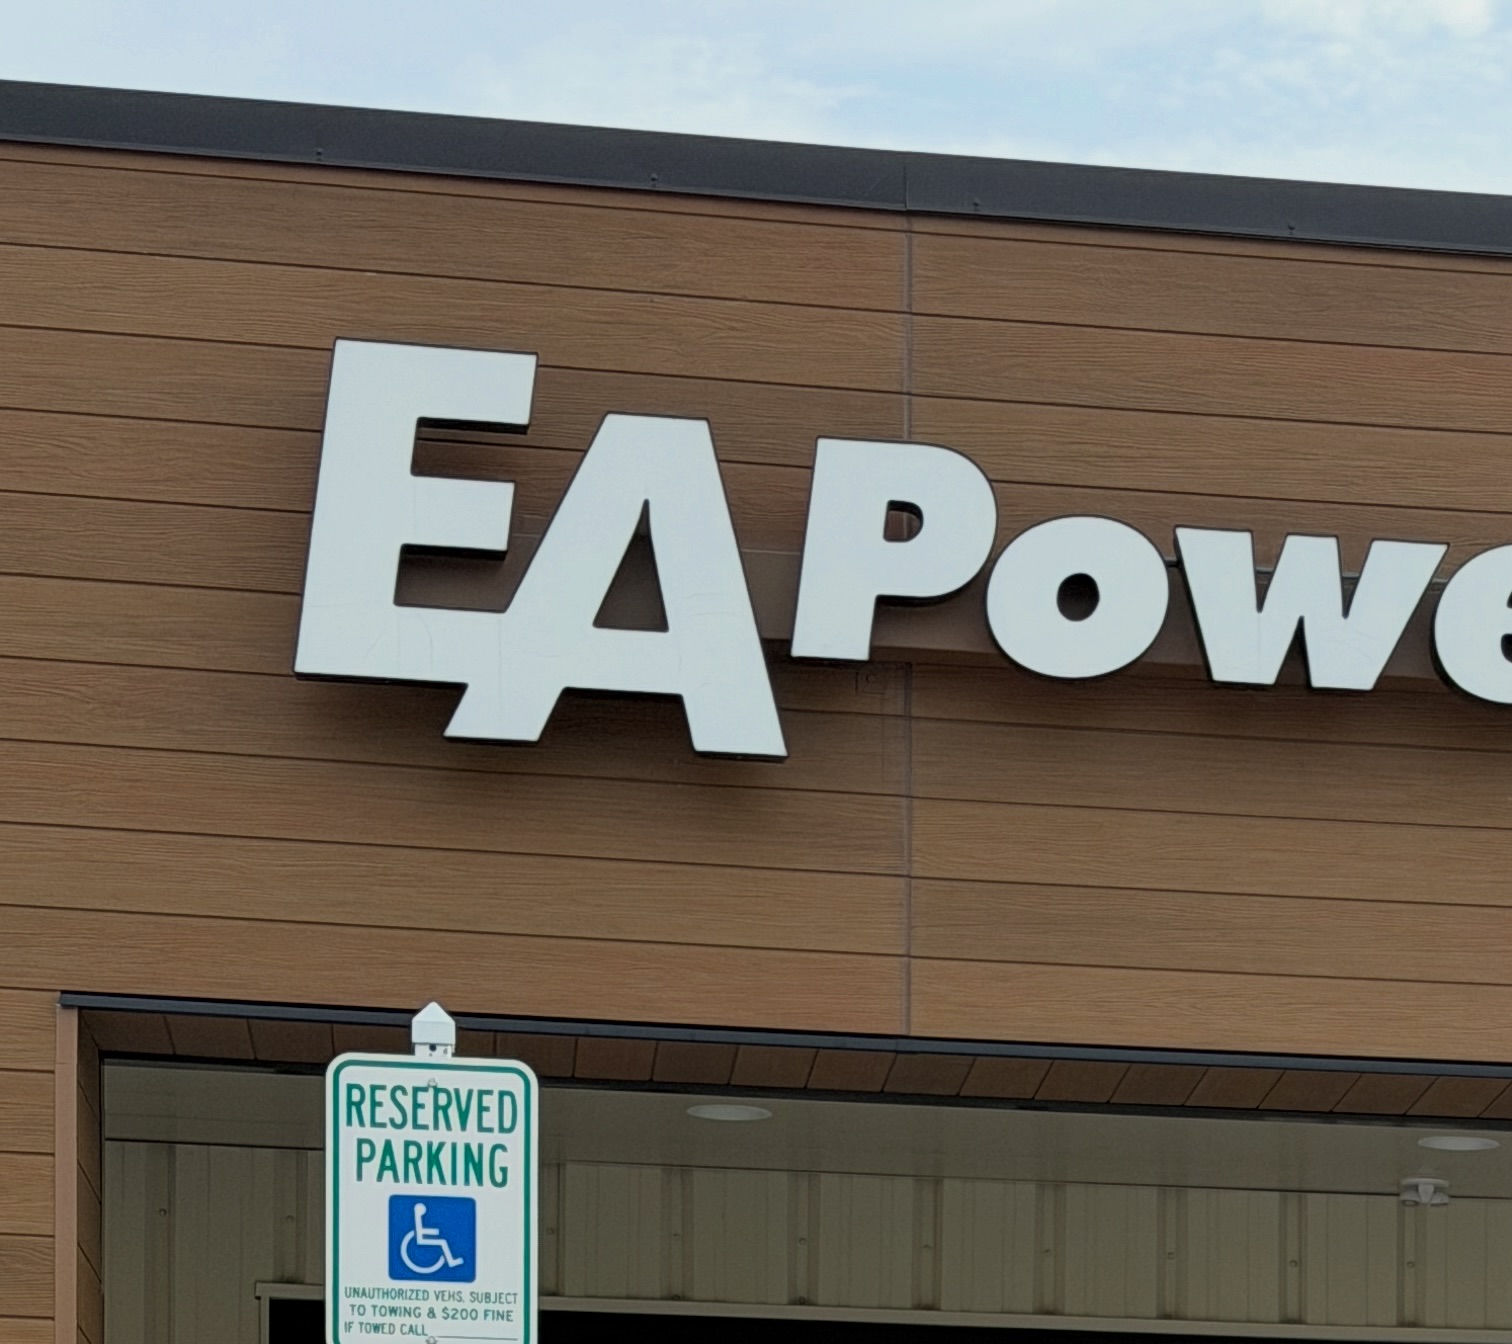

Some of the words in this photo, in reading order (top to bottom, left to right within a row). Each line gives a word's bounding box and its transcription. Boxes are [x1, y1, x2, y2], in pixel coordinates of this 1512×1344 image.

[346, 1083, 517, 1134] RESERVED
[356, 1138, 509, 1188] PARKING
[344, 1286, 430, 1302] UNAUTHORIZED
[469, 1291, 518, 1305] SUBJECT
[349, 1304, 366, 1317] TO
[371, 1305, 422, 1319] TOWING
[426, 1307, 437, 1319] &
[441, 1307, 479, 1321] $200
[483, 1309, 514, 1322] FINE
[344, 1321, 353, 1333] IF
[359, 1322, 396, 1335] TOWED
[400, 1323, 428, 1337] CALL
